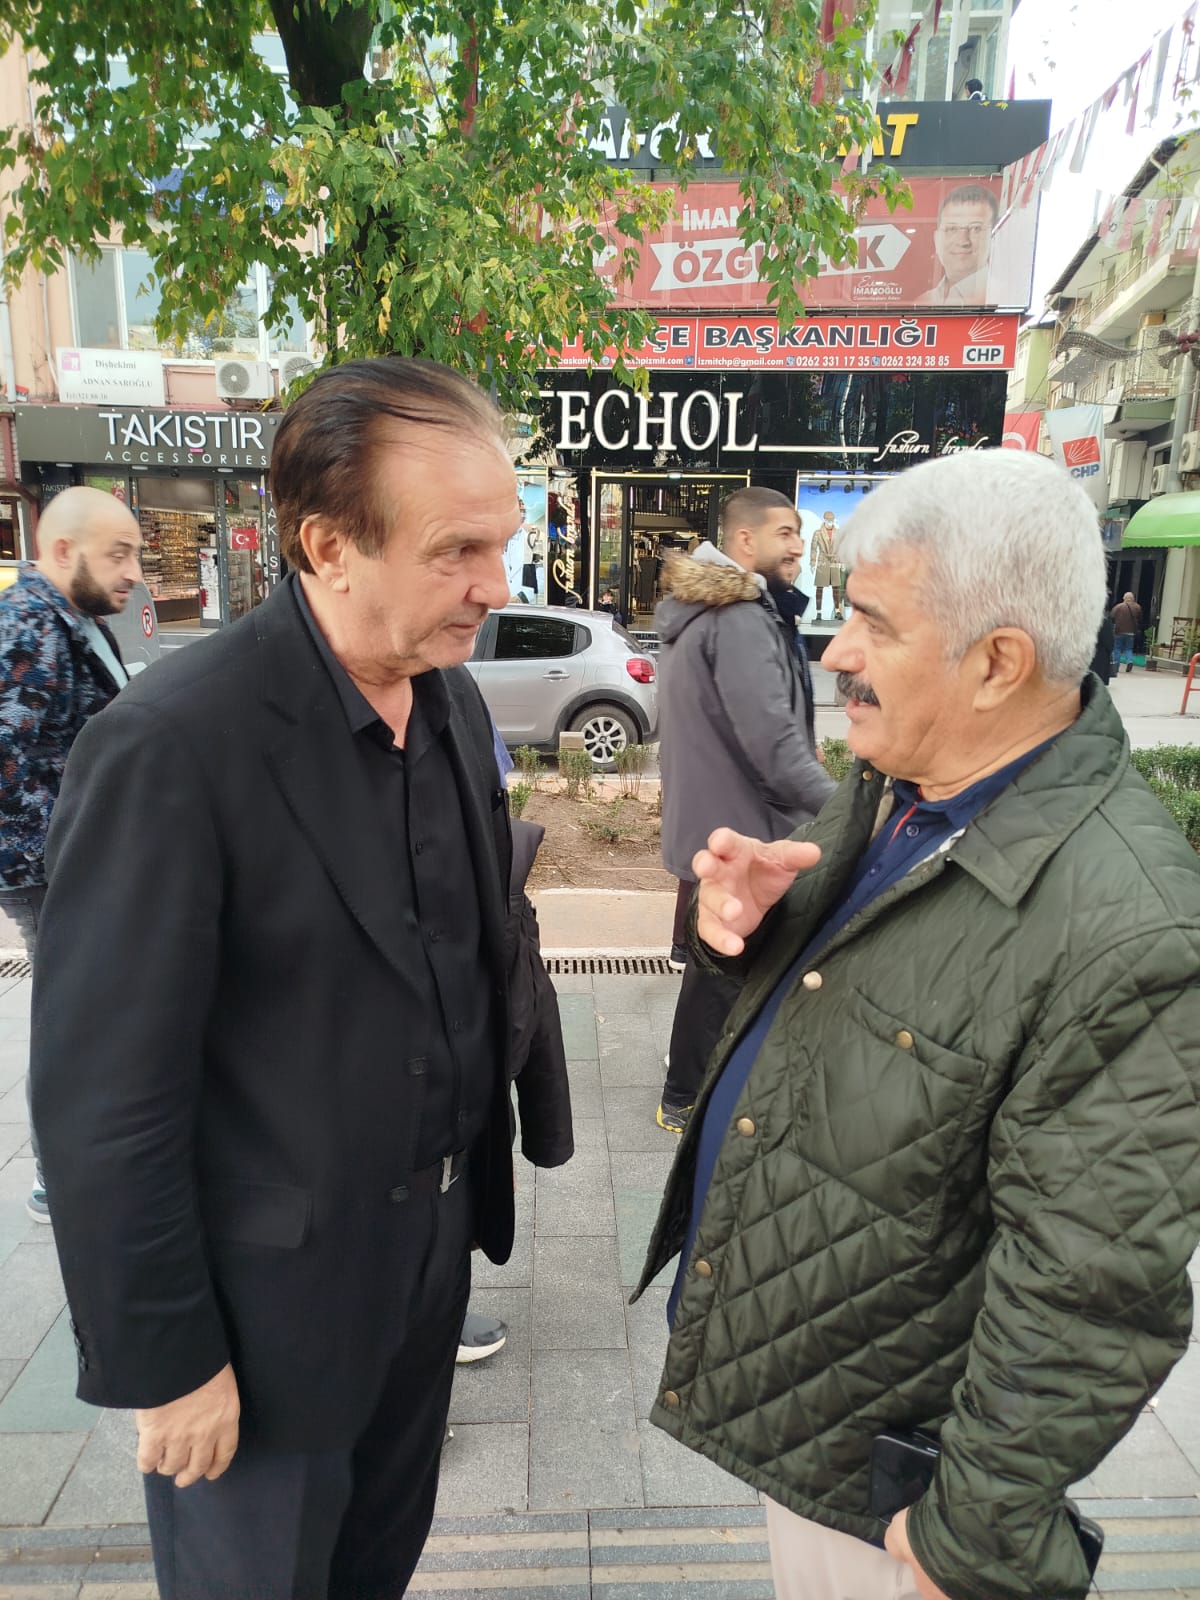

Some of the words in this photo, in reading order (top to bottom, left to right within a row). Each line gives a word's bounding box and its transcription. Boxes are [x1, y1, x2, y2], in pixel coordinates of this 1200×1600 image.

[704, 319, 938, 353] BAŞKANLIĞI
[698, 356, 784, 368] izmitchp@gmail.com
[796, 356, 820, 367] 0262
[823, 356, 840, 367] 331
[844, 356, 856, 367] 17
[858, 356, 870, 367] 35
[881, 355, 904, 367] 0262
[905, 355, 922, 367] 324
[925, 355, 936, 367] 38
[938, 355, 950, 367] 85
[966, 348, 1001, 362] CHP
[104, 451, 267, 466] ACCESSORIES
[1070, 463, 1101, 479] CHP
